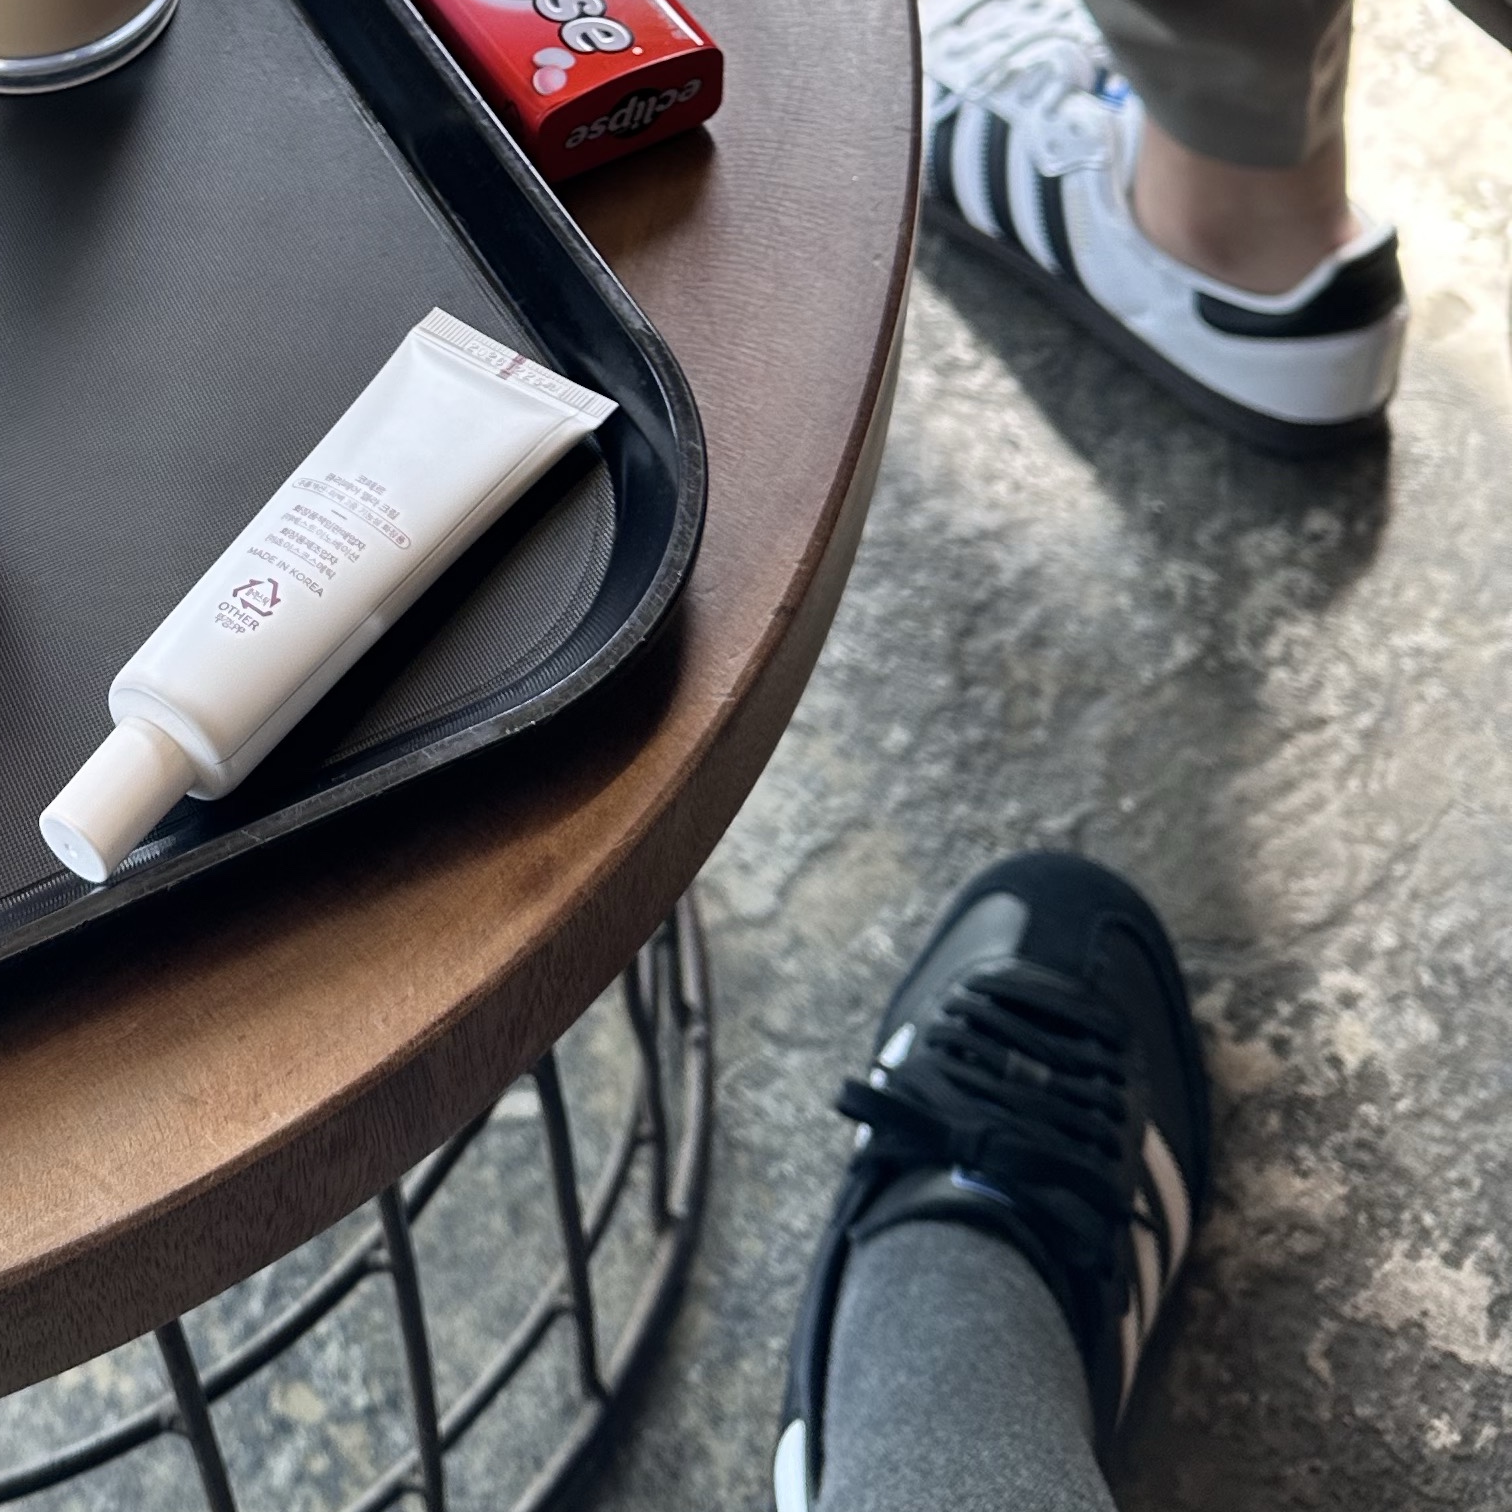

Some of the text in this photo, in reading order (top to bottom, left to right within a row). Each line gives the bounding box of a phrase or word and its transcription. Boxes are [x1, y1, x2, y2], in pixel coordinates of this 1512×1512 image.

[565, 78, 702, 149] eclipse
[246, 547, 324, 597] MADE IN KOREA
[218, 601, 259, 631] OTHER
